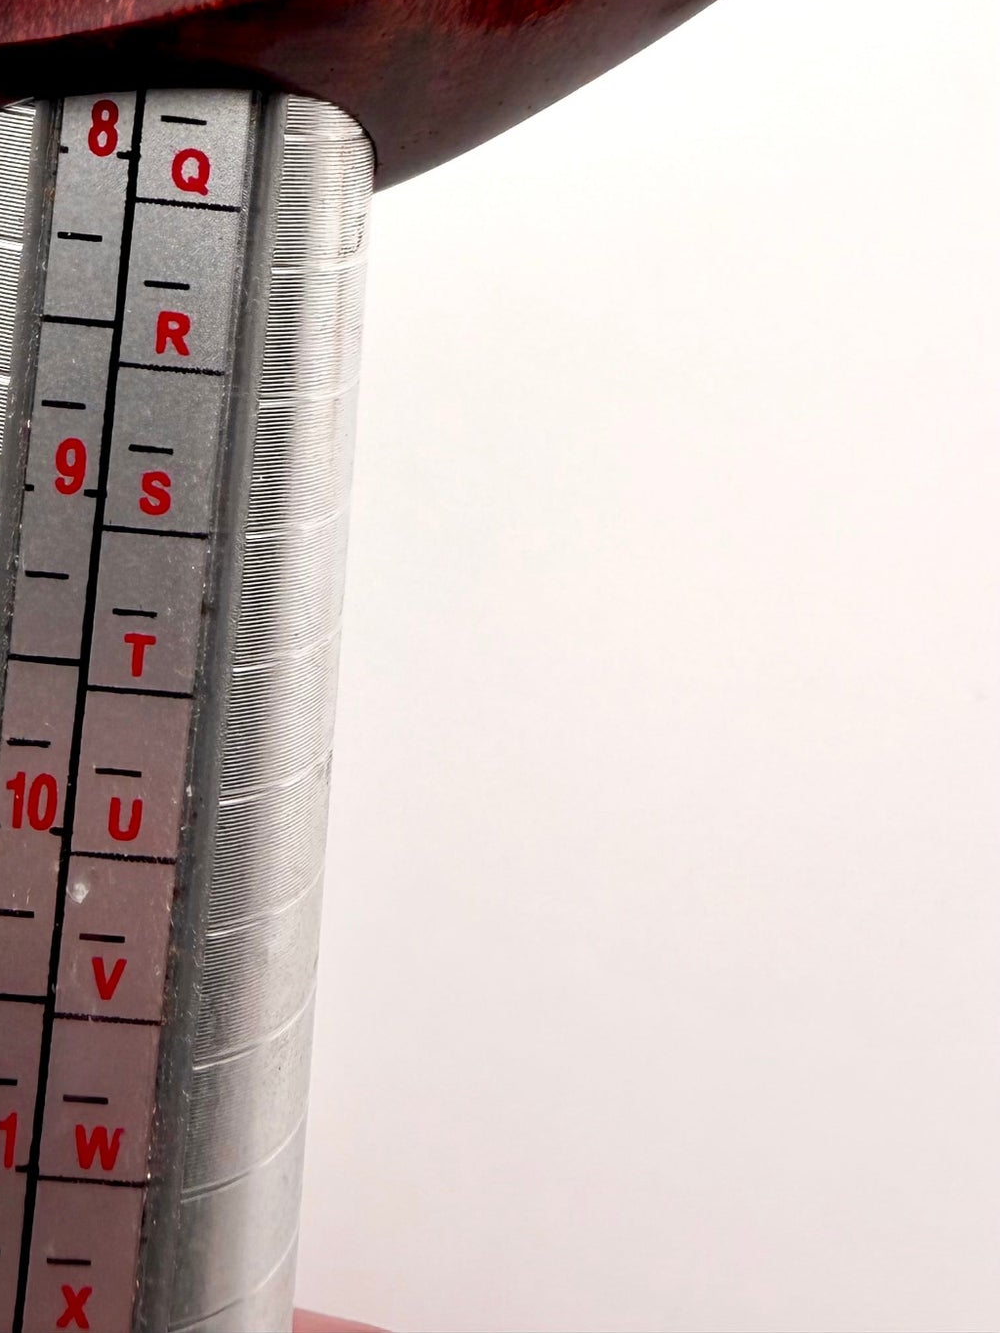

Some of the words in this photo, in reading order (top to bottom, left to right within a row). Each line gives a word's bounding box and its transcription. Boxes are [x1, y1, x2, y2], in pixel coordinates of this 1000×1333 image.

[87, 100, 119, 158] 8
[170, 147, 212, 197] Q
[154, 310, 192, 357] R
[53, 437, 88, 496] 9
[138, 470, 172, 517] S
[123, 632, 157, 678] T
[5, 770, 59, 832] 10
[107, 796, 144, 843] U
[90, 955, 128, 1002] V
[74, 1123, 125, 1173] W
[55, 1283, 94, 1332] X
